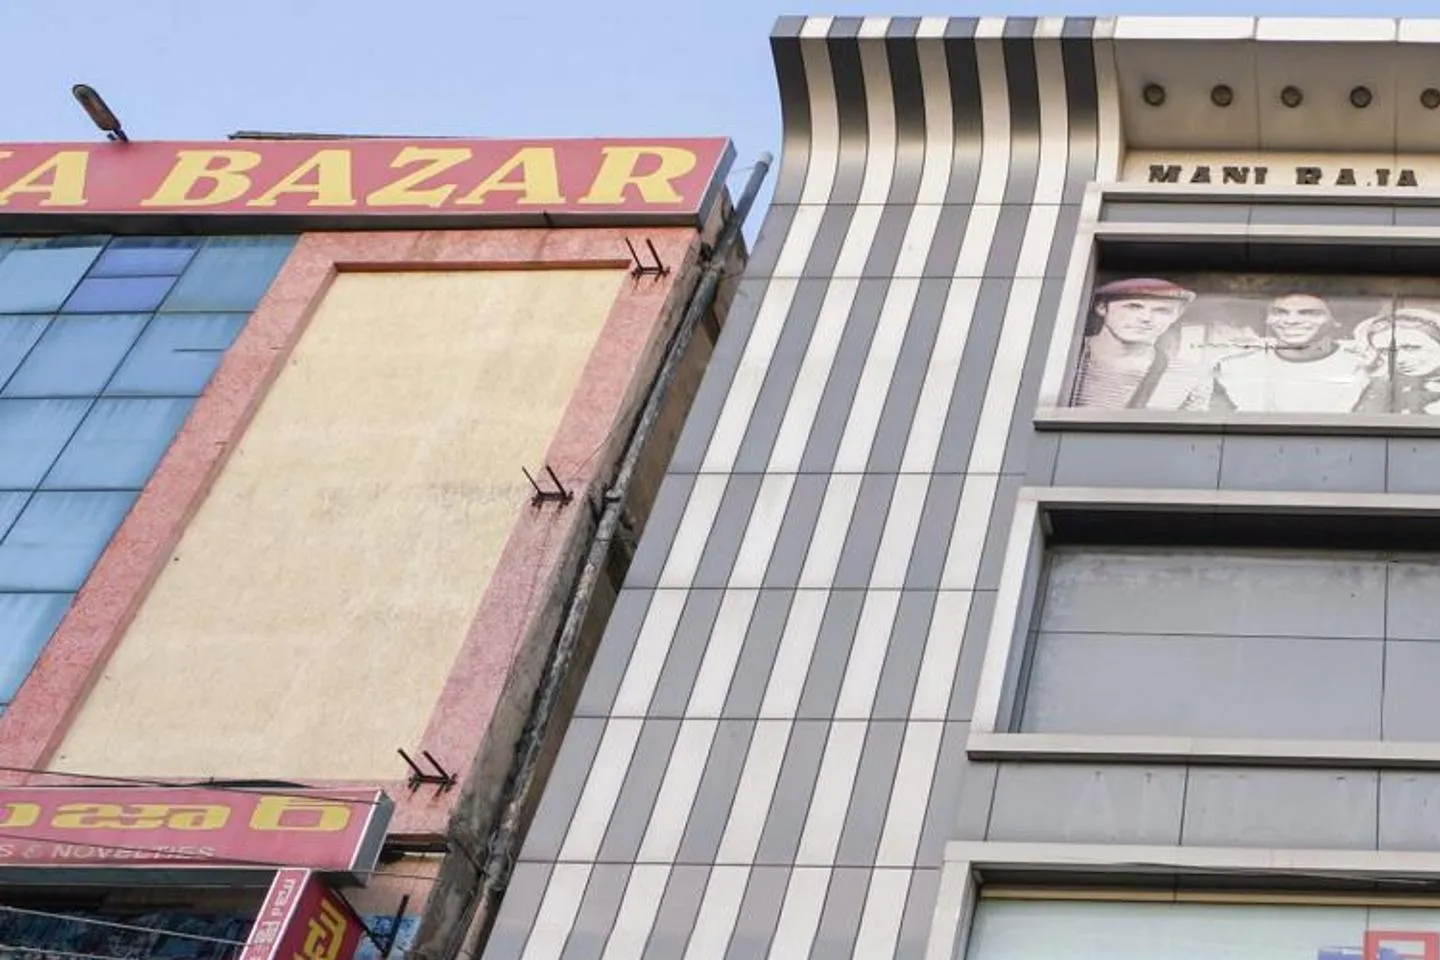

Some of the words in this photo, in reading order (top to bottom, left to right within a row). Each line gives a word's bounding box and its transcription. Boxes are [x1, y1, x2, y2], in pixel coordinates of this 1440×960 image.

[0, 151, 90, 207] A
[139, 146, 698, 208] BAZAR
[1148, 164, 1268, 184] MANI
[51, 844, 216, 859] NOVELTIES
